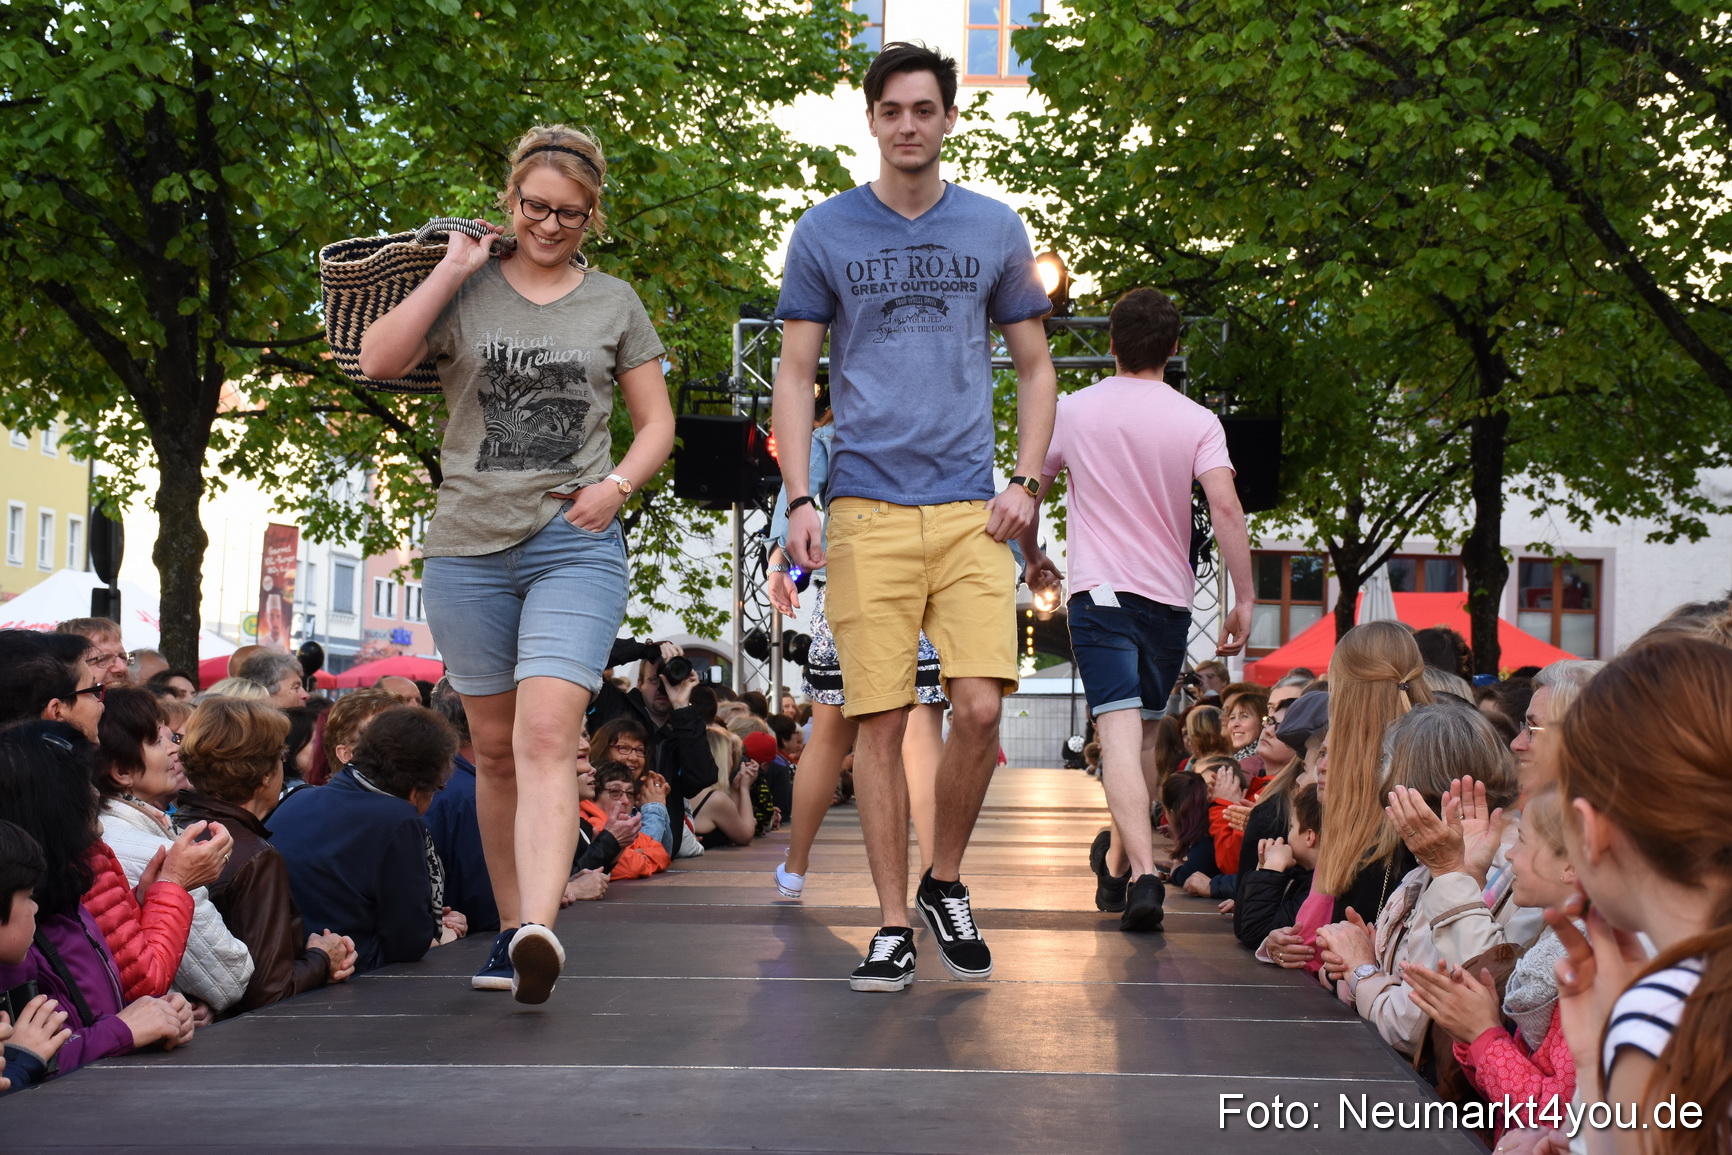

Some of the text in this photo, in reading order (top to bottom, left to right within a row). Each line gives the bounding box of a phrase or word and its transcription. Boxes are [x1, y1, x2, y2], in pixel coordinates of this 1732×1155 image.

[846, 254, 980, 283] OFF ROAD
[851, 281, 977, 296] GREAT OUTDOORS
[566, 388, 588, 398] MIDDLE
